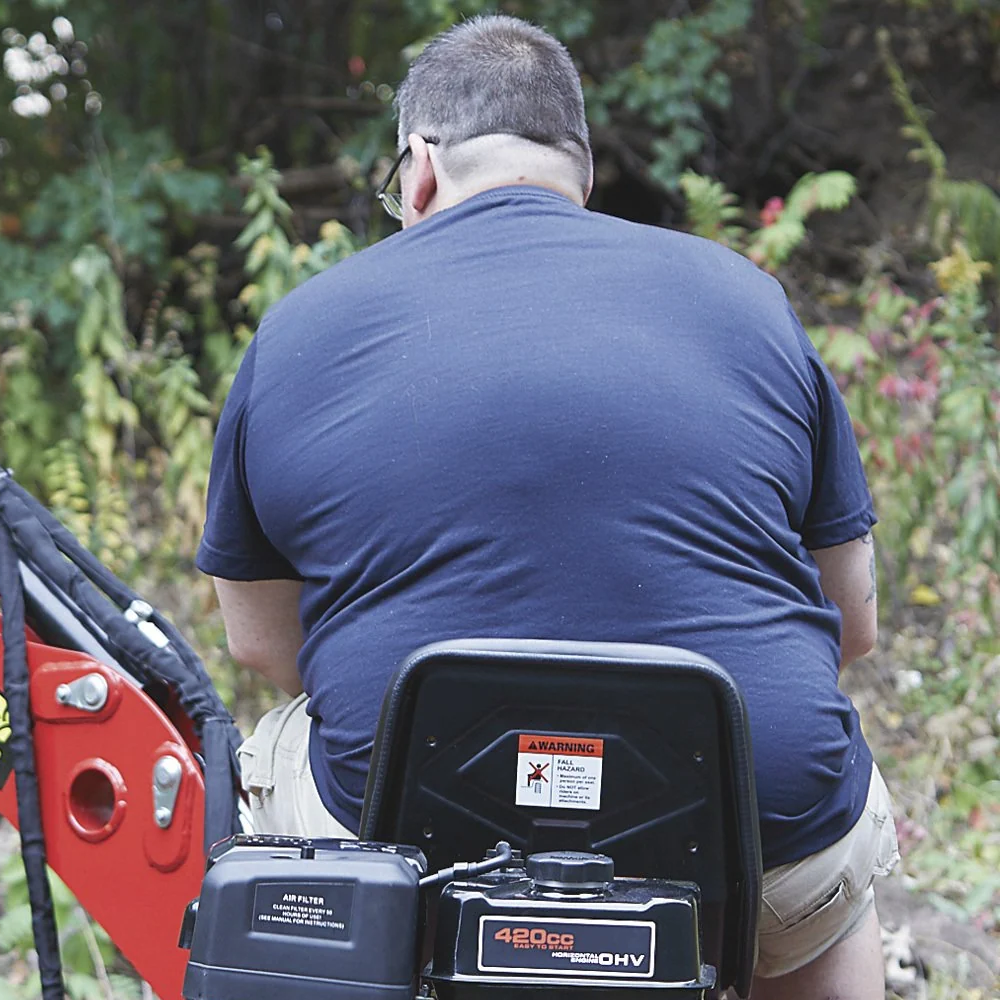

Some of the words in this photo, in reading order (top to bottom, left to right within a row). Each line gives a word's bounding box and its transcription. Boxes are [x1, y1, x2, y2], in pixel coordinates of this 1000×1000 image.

[538, 741, 595, 753] WARNING
[282, 893, 297, 903] AIR
[297, 895, 324, 905] FILTER
[272, 903, 291, 911] CLEAN
[291, 905, 308, 913] FILTER
[308, 907, 326, 915] EVERY
[271, 915, 292, 924] MANUAL
[494, 927, 575, 945] 420cc
[551, 951, 599, 959] HORIZONTAL
[598, 953, 645, 967] OHV
